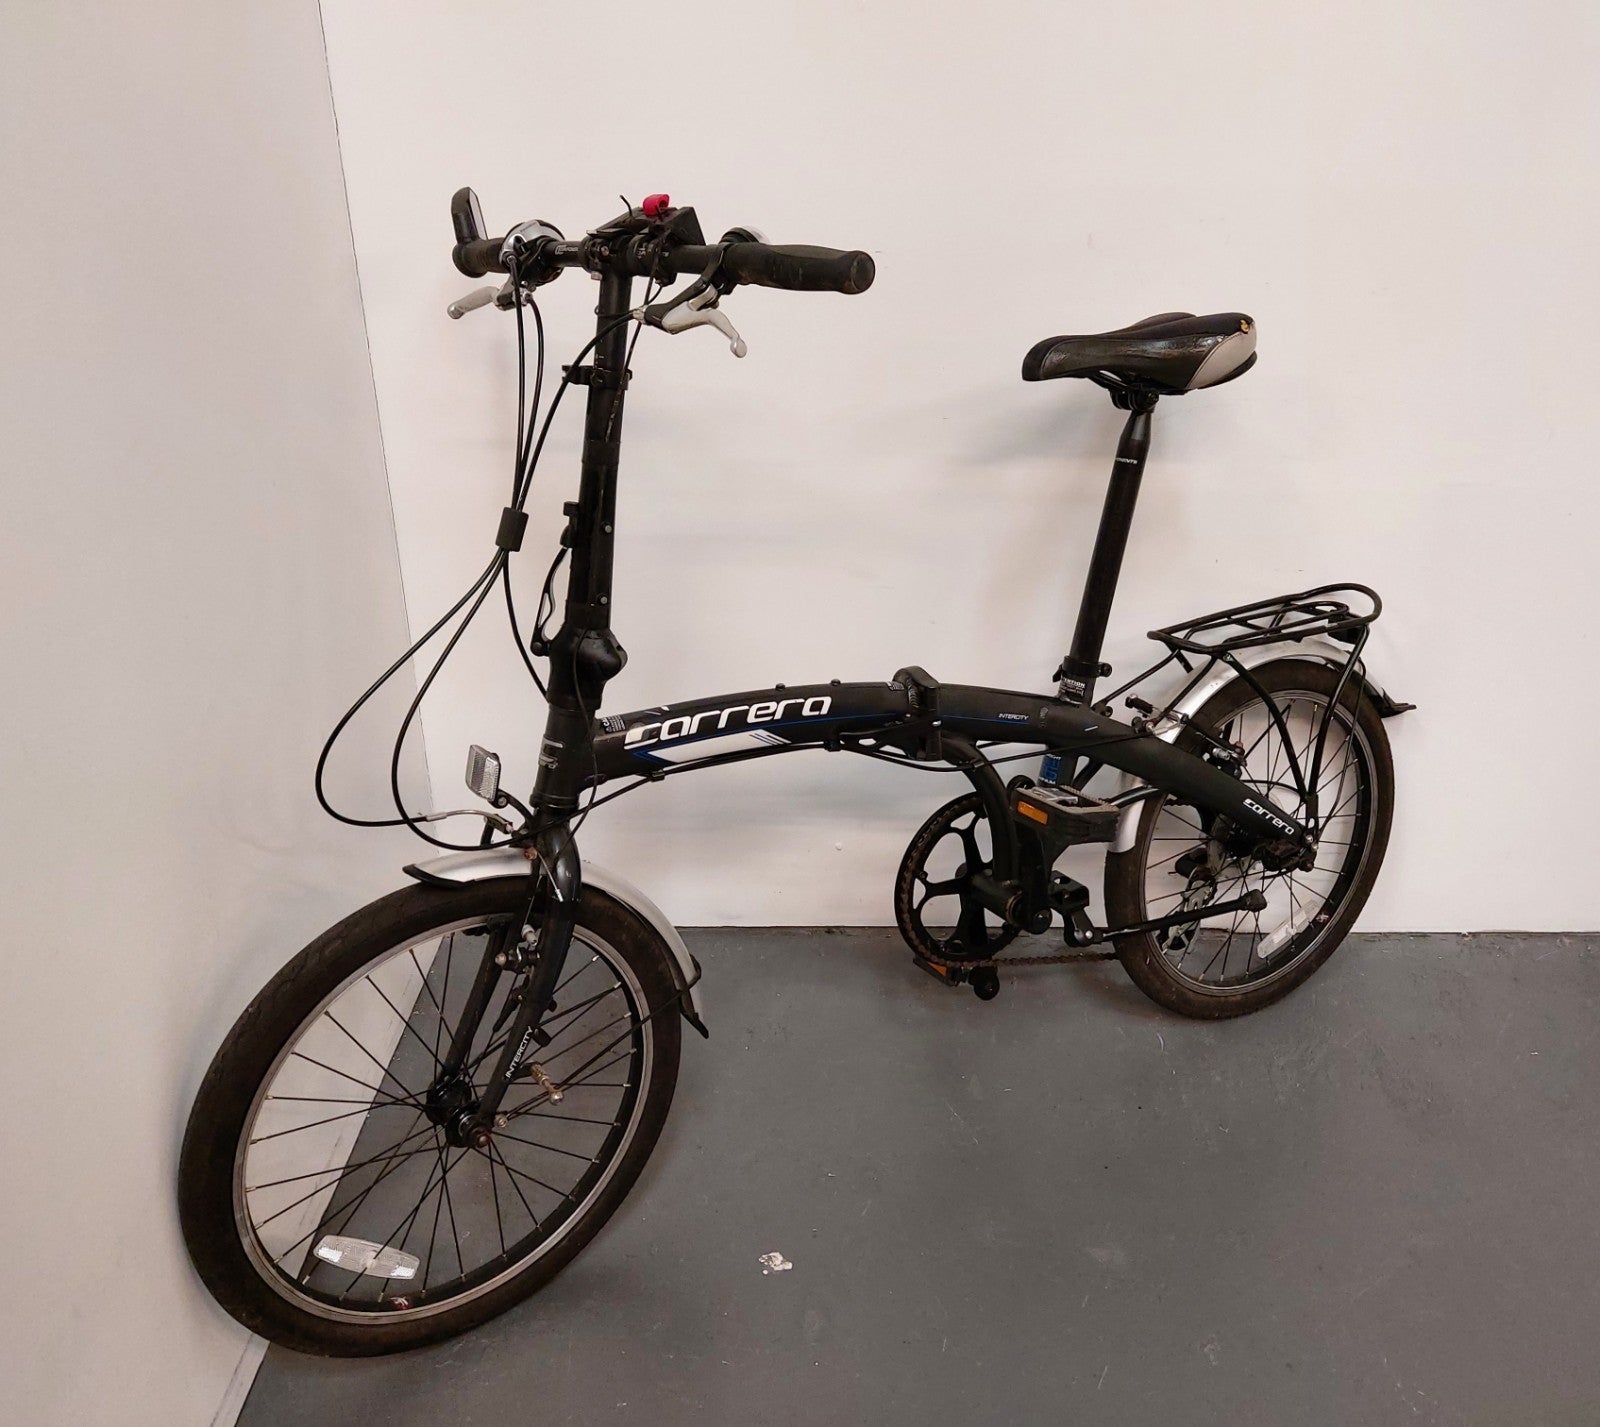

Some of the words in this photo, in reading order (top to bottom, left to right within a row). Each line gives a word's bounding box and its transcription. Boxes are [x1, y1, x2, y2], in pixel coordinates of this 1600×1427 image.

[623, 696, 833, 750] carrera
[998, 713, 1029, 722] INTERCITY
[1242, 797, 1295, 836] carrera
[504, 1025, 533, 1079] INTERCITY
